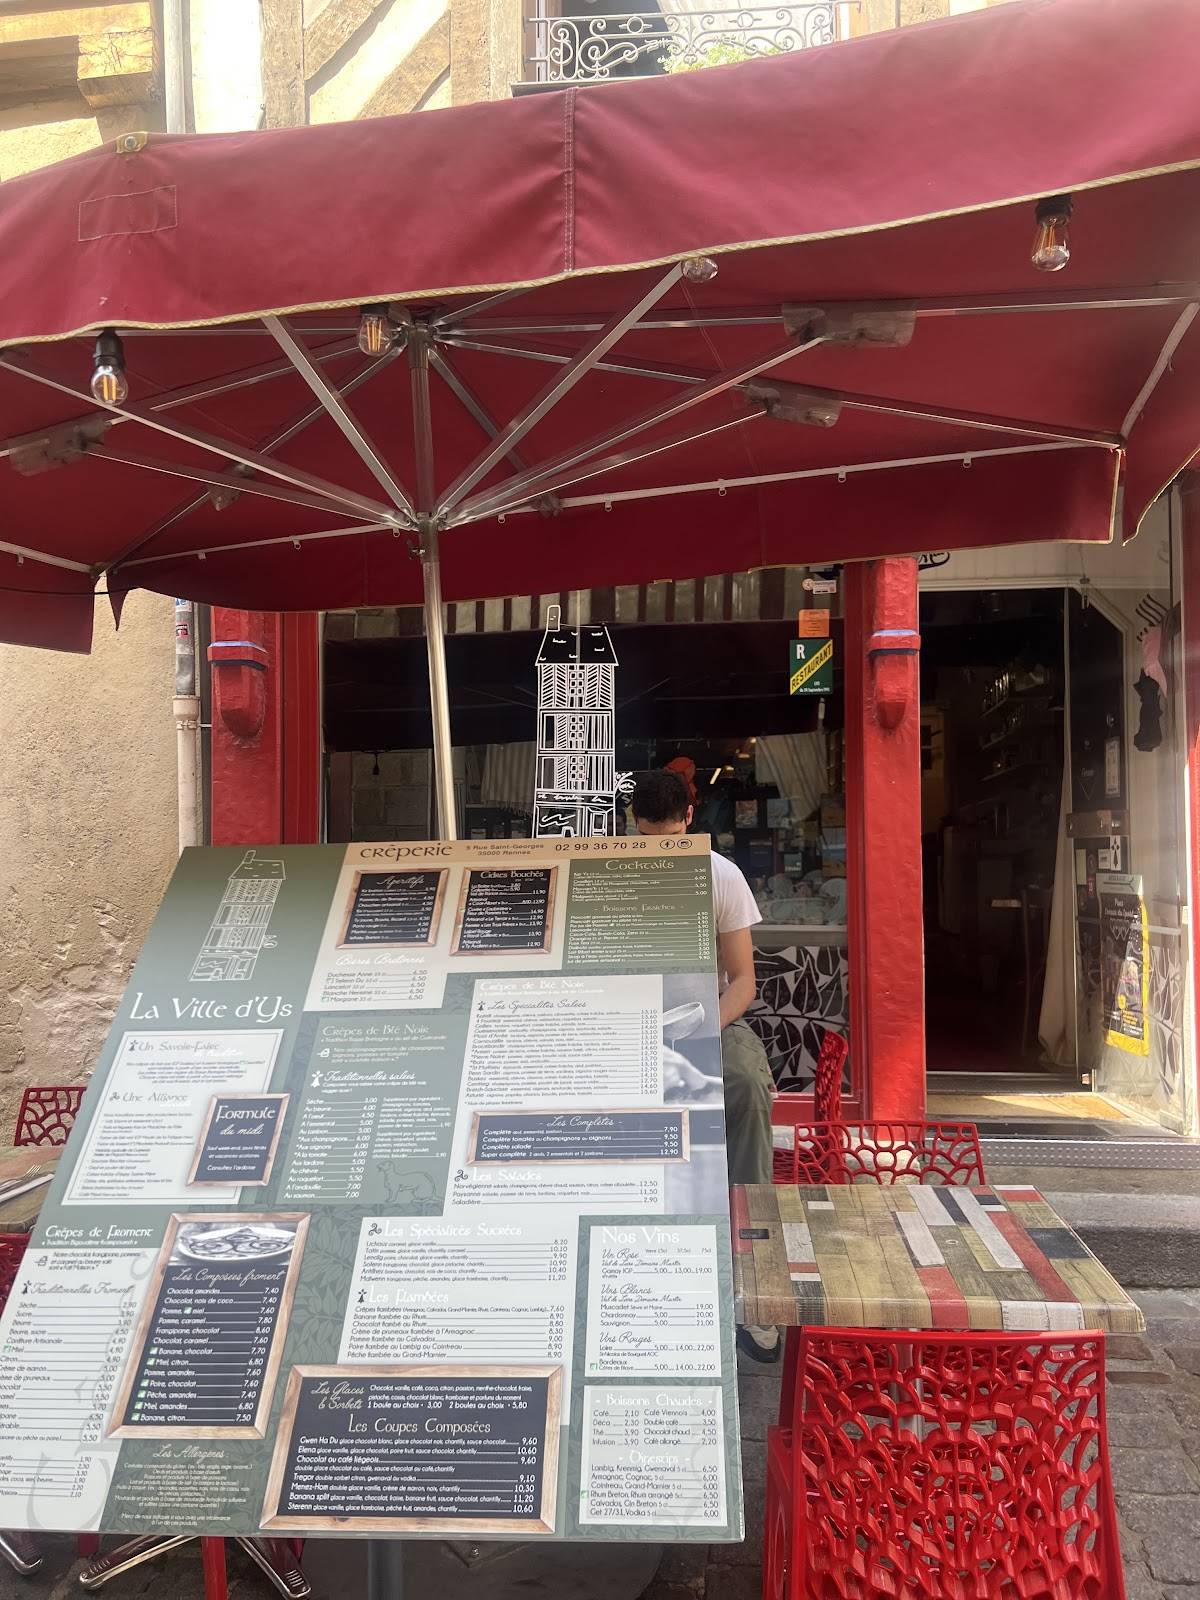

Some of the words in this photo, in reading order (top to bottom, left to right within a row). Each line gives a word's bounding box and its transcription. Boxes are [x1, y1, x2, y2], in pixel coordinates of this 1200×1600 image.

[796, 644, 805, 659] R
[791, 644, 832, 689] RESTAURANT
[606, 860, 674, 871] Cocktails
[129, 992, 159, 1019] La
[172, 998, 227, 1018] Ville
[235, 996, 293, 1023] d'Ys
[488, 1001, 505, 1010] Les
[322, 1025, 362, 1036] Crêpes
[366, 1026, 378, 1035] de
[382, 1024, 400, 1035] Blé
[404, 1024, 430, 1034] Noir
[122, 1092, 143, 1101] Une
[148, 1092, 188, 1101] Alliance
[216, 1105, 276, 1122] Formule
[219, 1125, 235, 1135] du
[237, 1124, 264, 1135] midi
[546, 1116, 566, 1127] Les
[569, 1115, 615, 1131] Complètes
[483, 1135, 511, 1143] Complète
[543, 1135, 580, 1143] champignons
[588, 1134, 611, 1142] oignons
[480, 1151, 498, 1159] Super
[498, 1150, 526, 1158] complète
[472, 1168, 497, 1181] Les
[499, 1168, 543, 1181] Salades
[46, 1225, 84, 1240] Crêpes
[89, 1227, 102, 1236] de
[107, 1224, 154, 1239] Froment
[384, 1220, 404, 1237] Les
[410, 1222, 471, 1240] Spécialités
[476, 1222, 522, 1237] Sucrées
[602, 1227, 636, 1244] Nos
[642, 1227, 680, 1244] Vins
[602, 1249, 615, 1259] Vin
[617, 1248, 639, 1259] Rosé
[172, 1268, 194, 1281] Les
[195, 1269, 242, 1287] Composées
[239, 1270, 286, 1287] froment
[369, 1285, 389, 1303] Les
[395, 1288, 449, 1305] Flambées
[601, 1285, 617, 1294] Vins
[620, 1284, 651, 1294] Blancs
[355, 1306, 376, 1314] Crêpes
[599, 1333, 616, 1343] Vins
[619, 1332, 652, 1348] Rouges
[311, 1381, 330, 1394] Les
[332, 1381, 365, 1400] Glaces
[328, 1397, 363, 1409] Sorbets
[349, 1413, 368, 1433] Les
[375, 1418, 418, 1436] Coupes
[425, 1418, 491, 1436] Composées
[300, 1436, 317, 1444] Gwen
[153, 1444, 171, 1458] Les
[513, 1505, 533, 1513] 10,60
